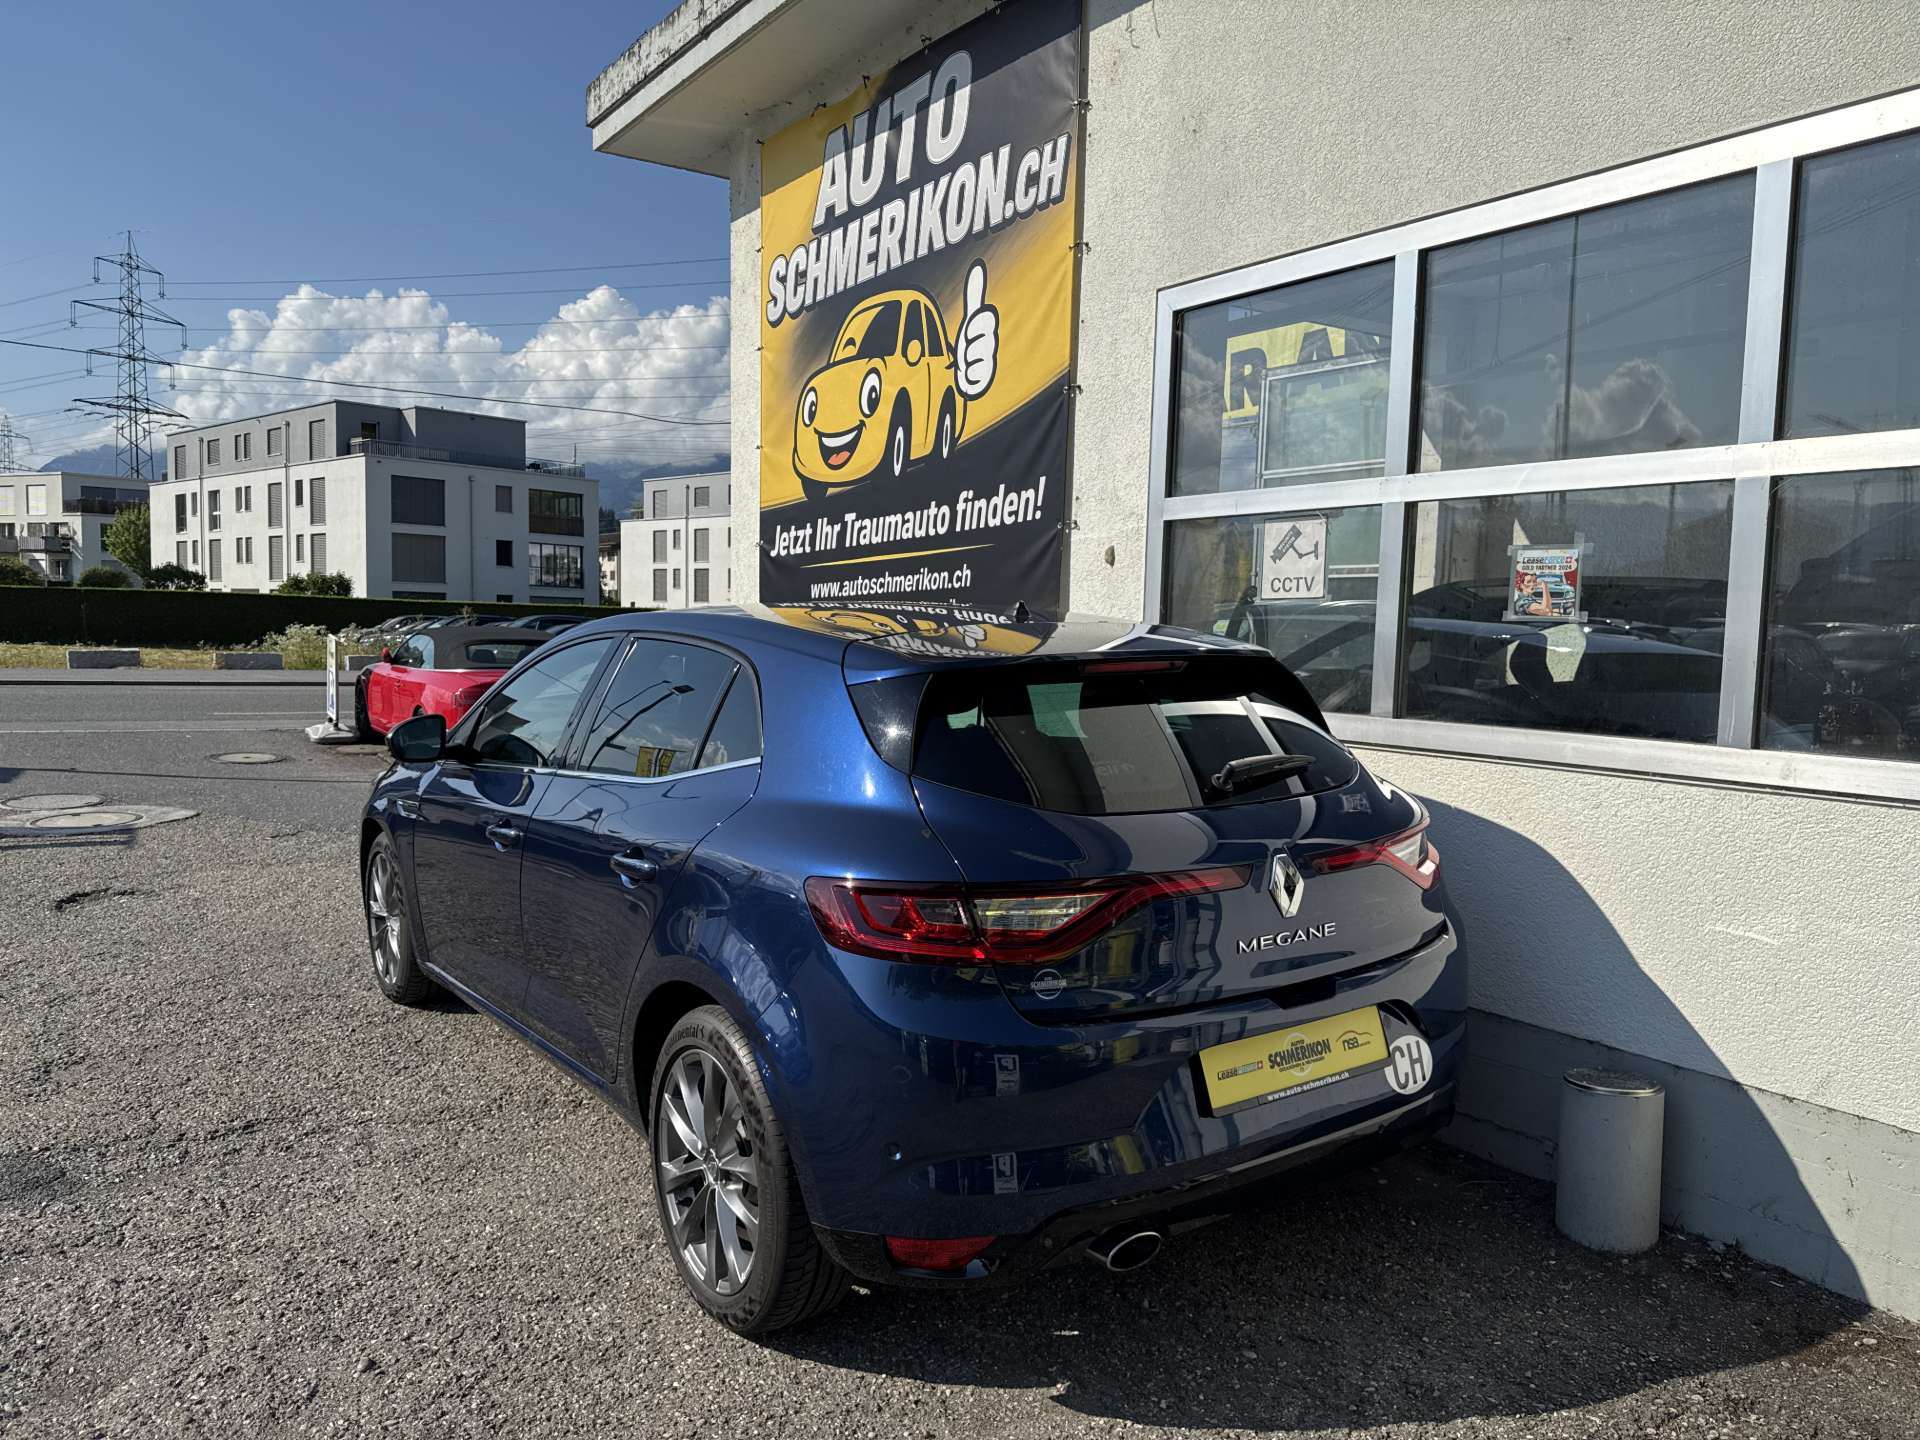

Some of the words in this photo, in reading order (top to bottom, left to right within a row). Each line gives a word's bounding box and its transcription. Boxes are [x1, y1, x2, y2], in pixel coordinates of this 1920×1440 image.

[813, 50, 972, 229] AUTO
[766, 133, 1069, 325] SCHMERIKON.CH
[769, 524, 813, 558] Jetzt
[815, 517, 841, 552] Ihr
[844, 502, 950, 548] Traumauto
[955, 476, 1047, 533] finden!
[810, 564, 972, 599] www.autoschmerikon.ch
[1270, 576, 1315, 593] CCTV
[1237, 922, 1337, 954] MEGANE
[1268, 1038, 1332, 1070] SCHMERIKON
[1342, 1036, 1360, 1051] nsa
[1392, 1040, 1427, 1090] CH
[1267, 1071, 1350, 1101] www.auto-schmerikon.ch
